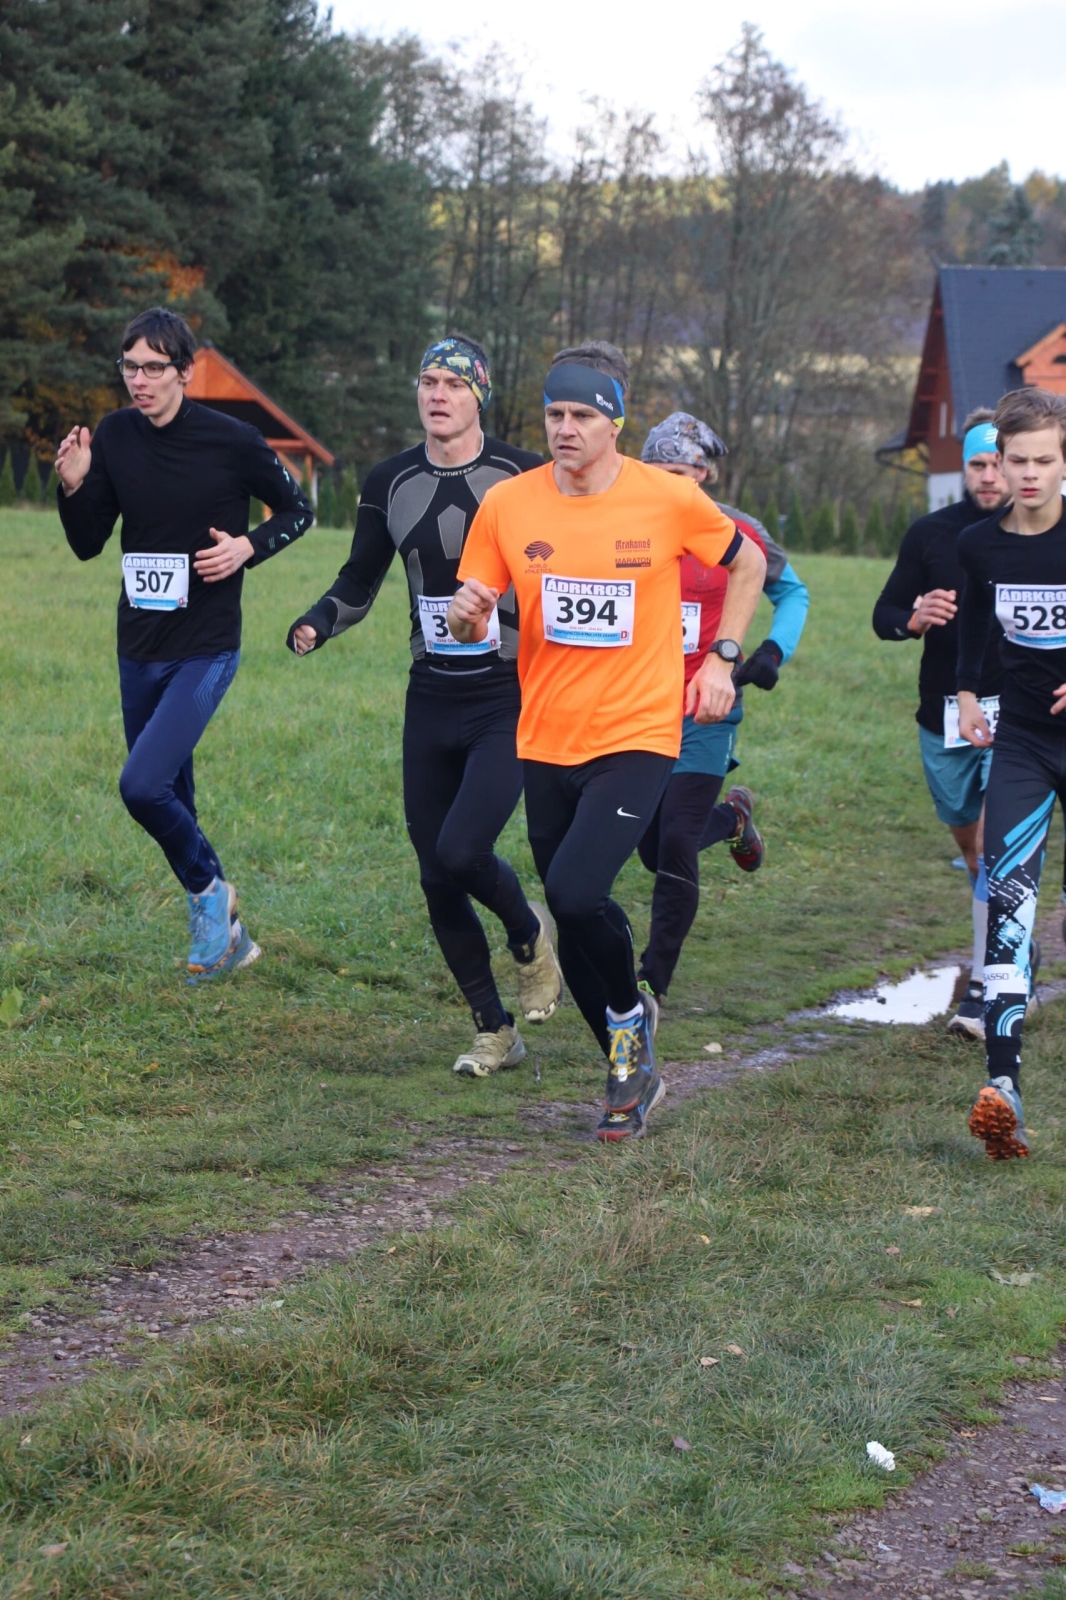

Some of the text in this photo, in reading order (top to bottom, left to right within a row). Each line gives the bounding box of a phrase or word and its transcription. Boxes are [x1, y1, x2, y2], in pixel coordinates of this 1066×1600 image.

[615, 557, 652, 565] MARATON
[135, 570, 175, 594] 507
[546, 579, 630, 596] ÁDRKROS
[556, 596, 618, 626] 394
[1013, 604, 1066, 631] 528
